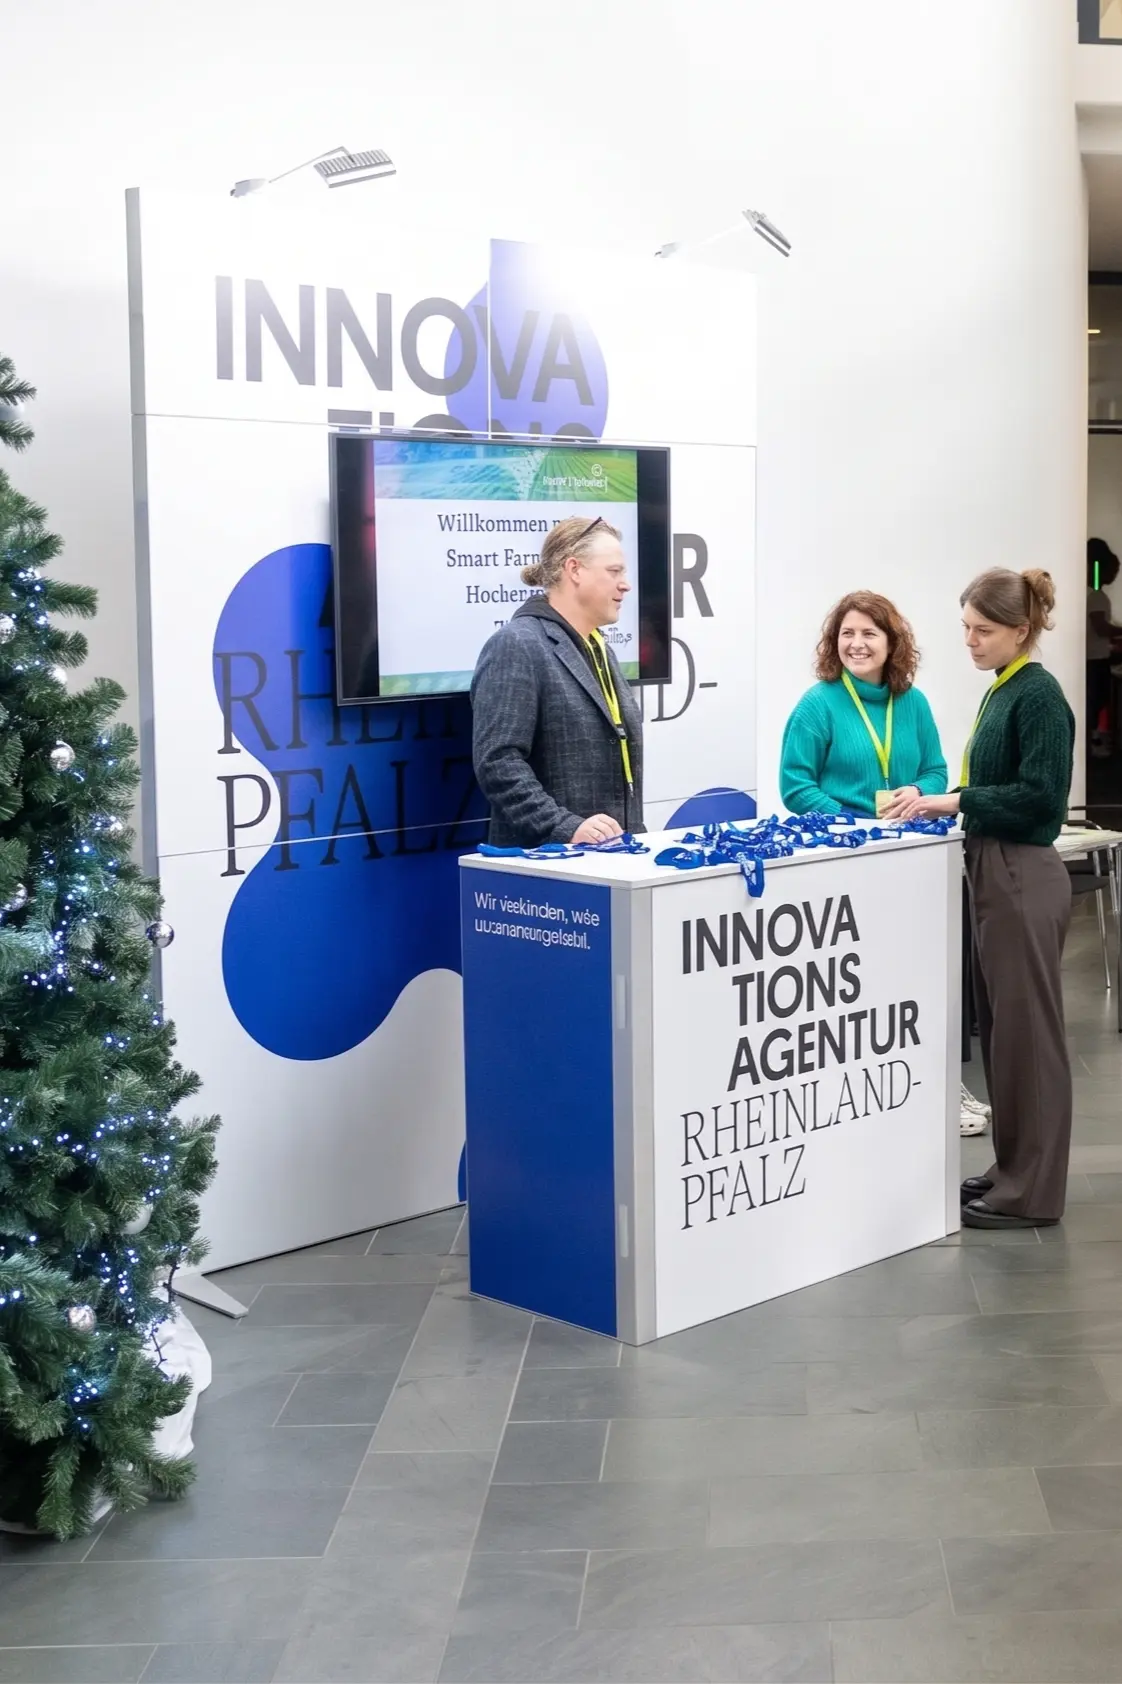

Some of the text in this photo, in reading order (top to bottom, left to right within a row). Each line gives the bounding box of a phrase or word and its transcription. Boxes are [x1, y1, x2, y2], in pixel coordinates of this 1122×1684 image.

[215, 275, 595, 406] INNOVA
[437, 513, 549, 532] Willkommen
[446, 548, 499, 568] Smart
[216, 756, 490, 877] PFALZ
[474, 891, 497, 911] Wir
[682, 894, 861, 975] INNOVA
[732, 952, 861, 1026] TIONS
[727, 1000, 922, 1092] AGENTUR
[681, 1059, 922, 1167] RHEINLAND-
[681, 1144, 807, 1230] PFALZ
